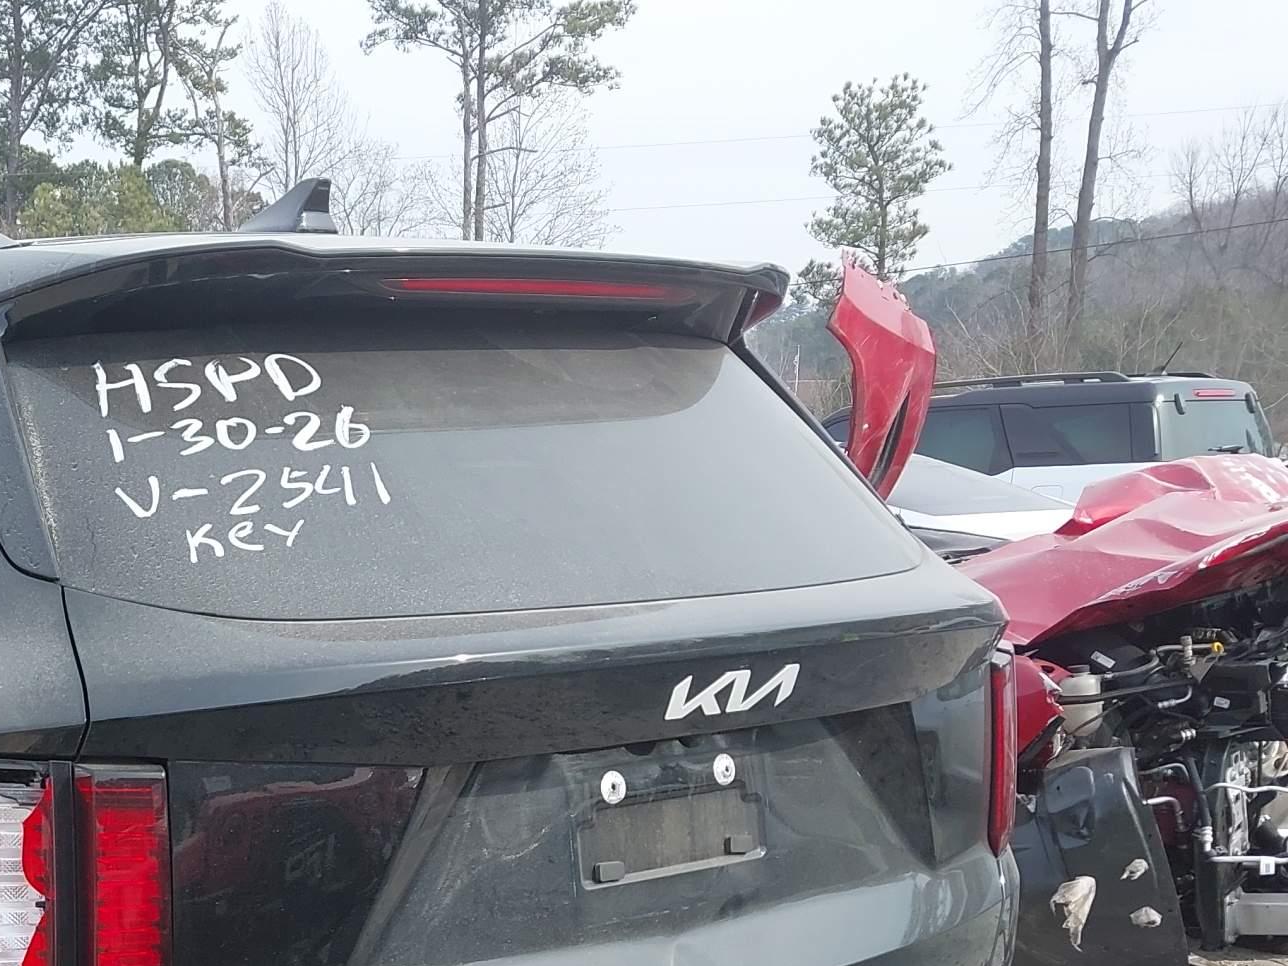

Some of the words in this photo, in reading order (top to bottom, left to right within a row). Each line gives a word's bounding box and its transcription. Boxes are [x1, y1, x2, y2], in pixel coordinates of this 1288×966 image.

[92, 353, 322, 418] HSPD
[106, 404, 371, 463] 1-30-26
[665, 663, 801, 721] KIA
